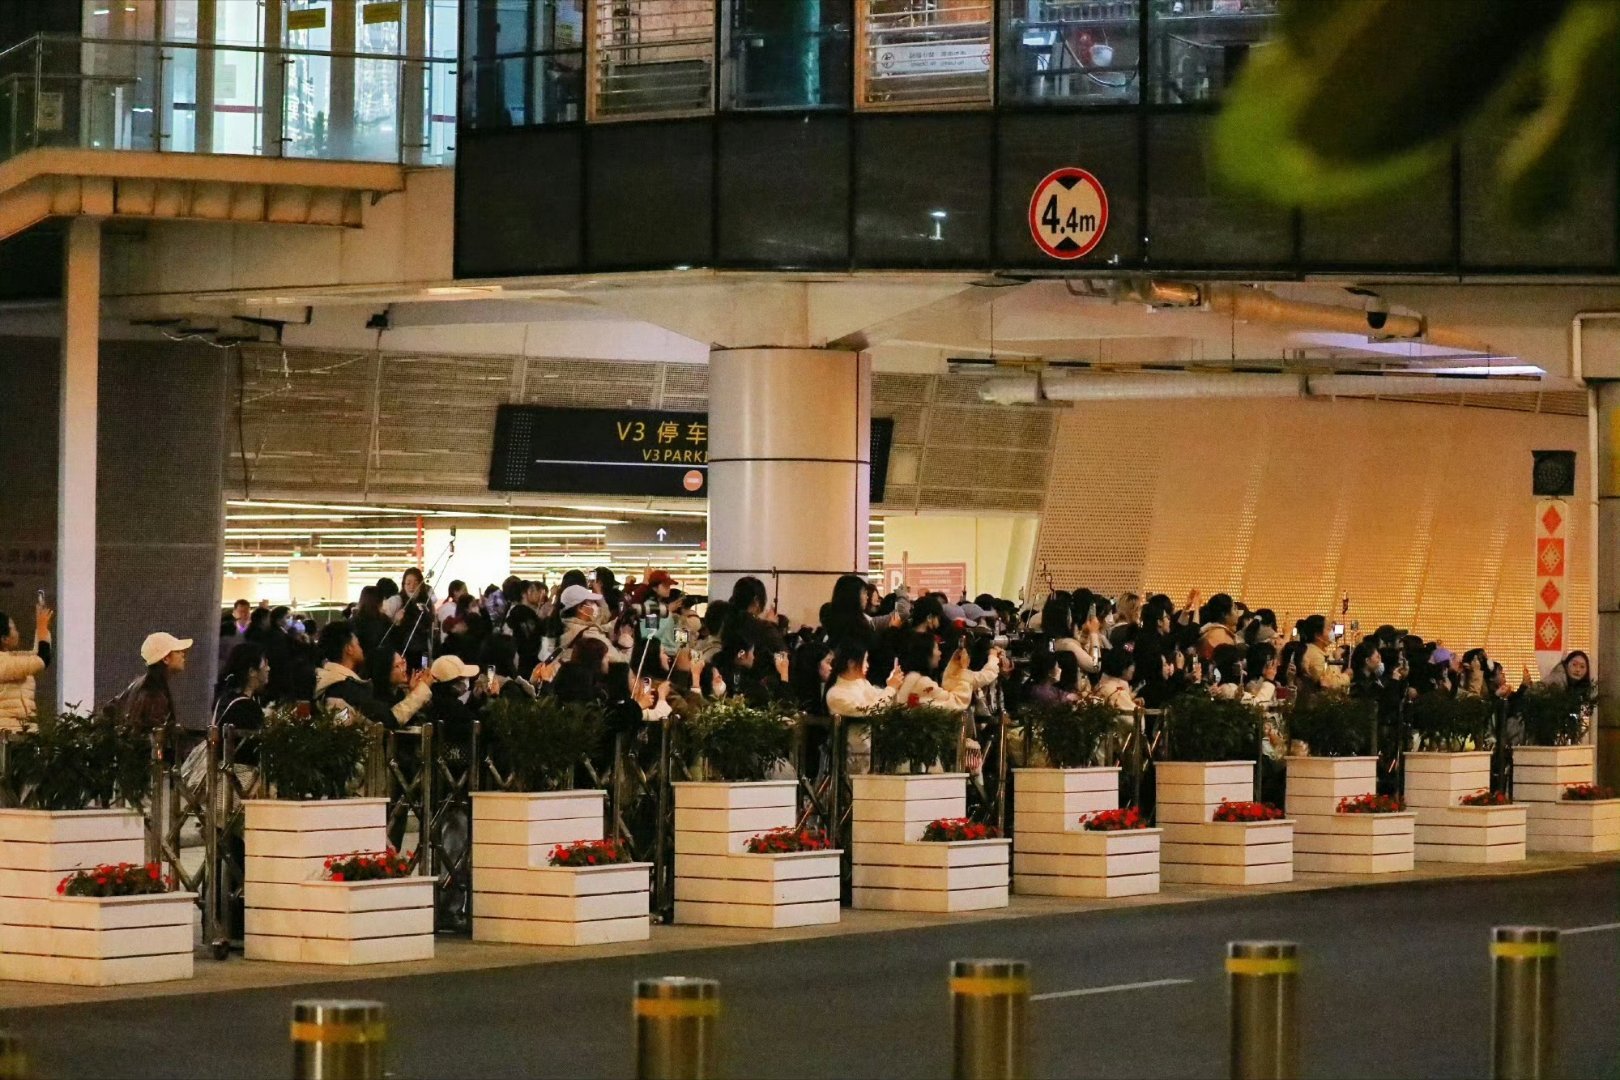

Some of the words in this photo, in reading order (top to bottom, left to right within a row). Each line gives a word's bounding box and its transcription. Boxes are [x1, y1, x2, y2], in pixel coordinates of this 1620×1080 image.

[1042, 194, 1096, 234] 4.4m
[617, 421, 645, 441] V3
[643, 449, 660, 461] V3
